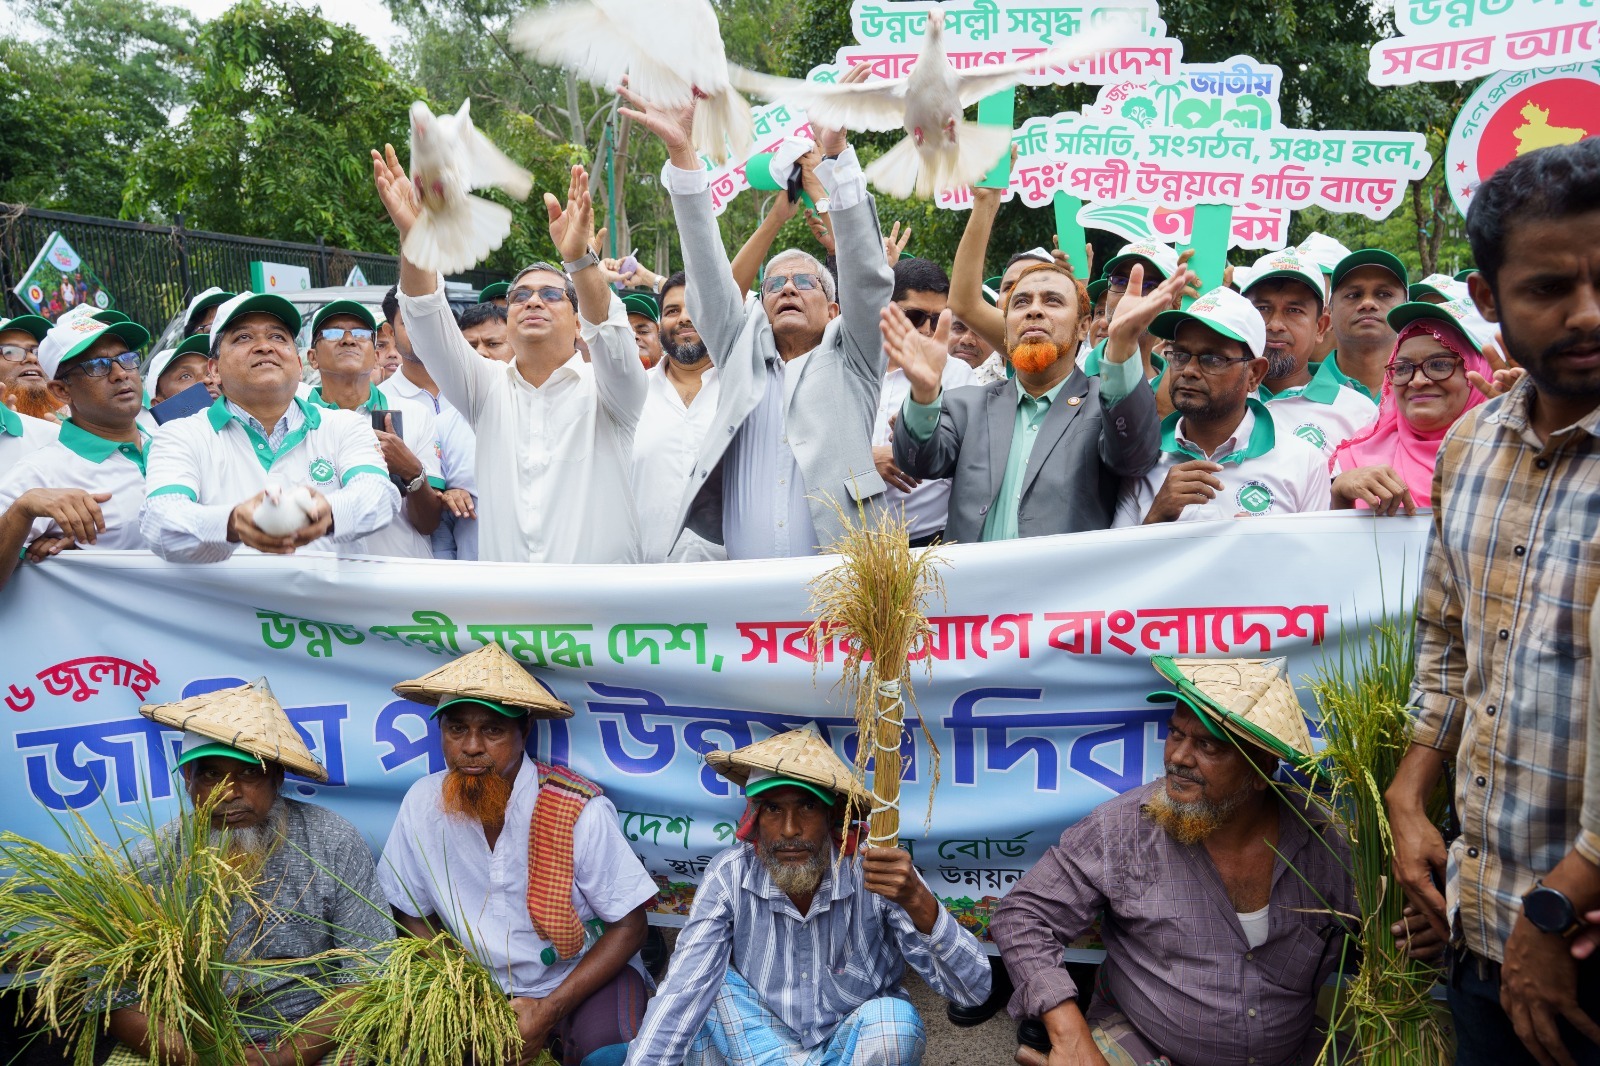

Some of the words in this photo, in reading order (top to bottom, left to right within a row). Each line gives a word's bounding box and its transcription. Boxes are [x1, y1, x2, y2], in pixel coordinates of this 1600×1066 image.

[1006, 7, 1083, 45] সমৃদ্ধ
[1382, 36, 1496, 76] সবার
[1505, 20, 1600, 60] আে
[1189, 63, 1274, 97] জাতীয়
[1055, 125, 1140, 161] সমিতি,
[1148, 128, 1260, 165] সংগঠন,
[1269, 138, 1346, 167] সঞ্চয়
[1352, 140, 1421, 170] হলে,
[1071, 158, 1130, 200] পল্লী
[1136, 162, 1245, 202] উন্নয়নে
[1251, 164, 1315, 201] গতি
[1320, 176, 1397, 212] বাড়ে
[253, 607, 366, 658] উন্নত
[608, 623, 724, 672] দেশ,
[1044, 604, 1328, 656] বাংলাদেশ
[5, 683, 35, 713] ৬
[36, 656, 160, 702] জুলাই
[938, 831, 1034, 860] বোর্ড
